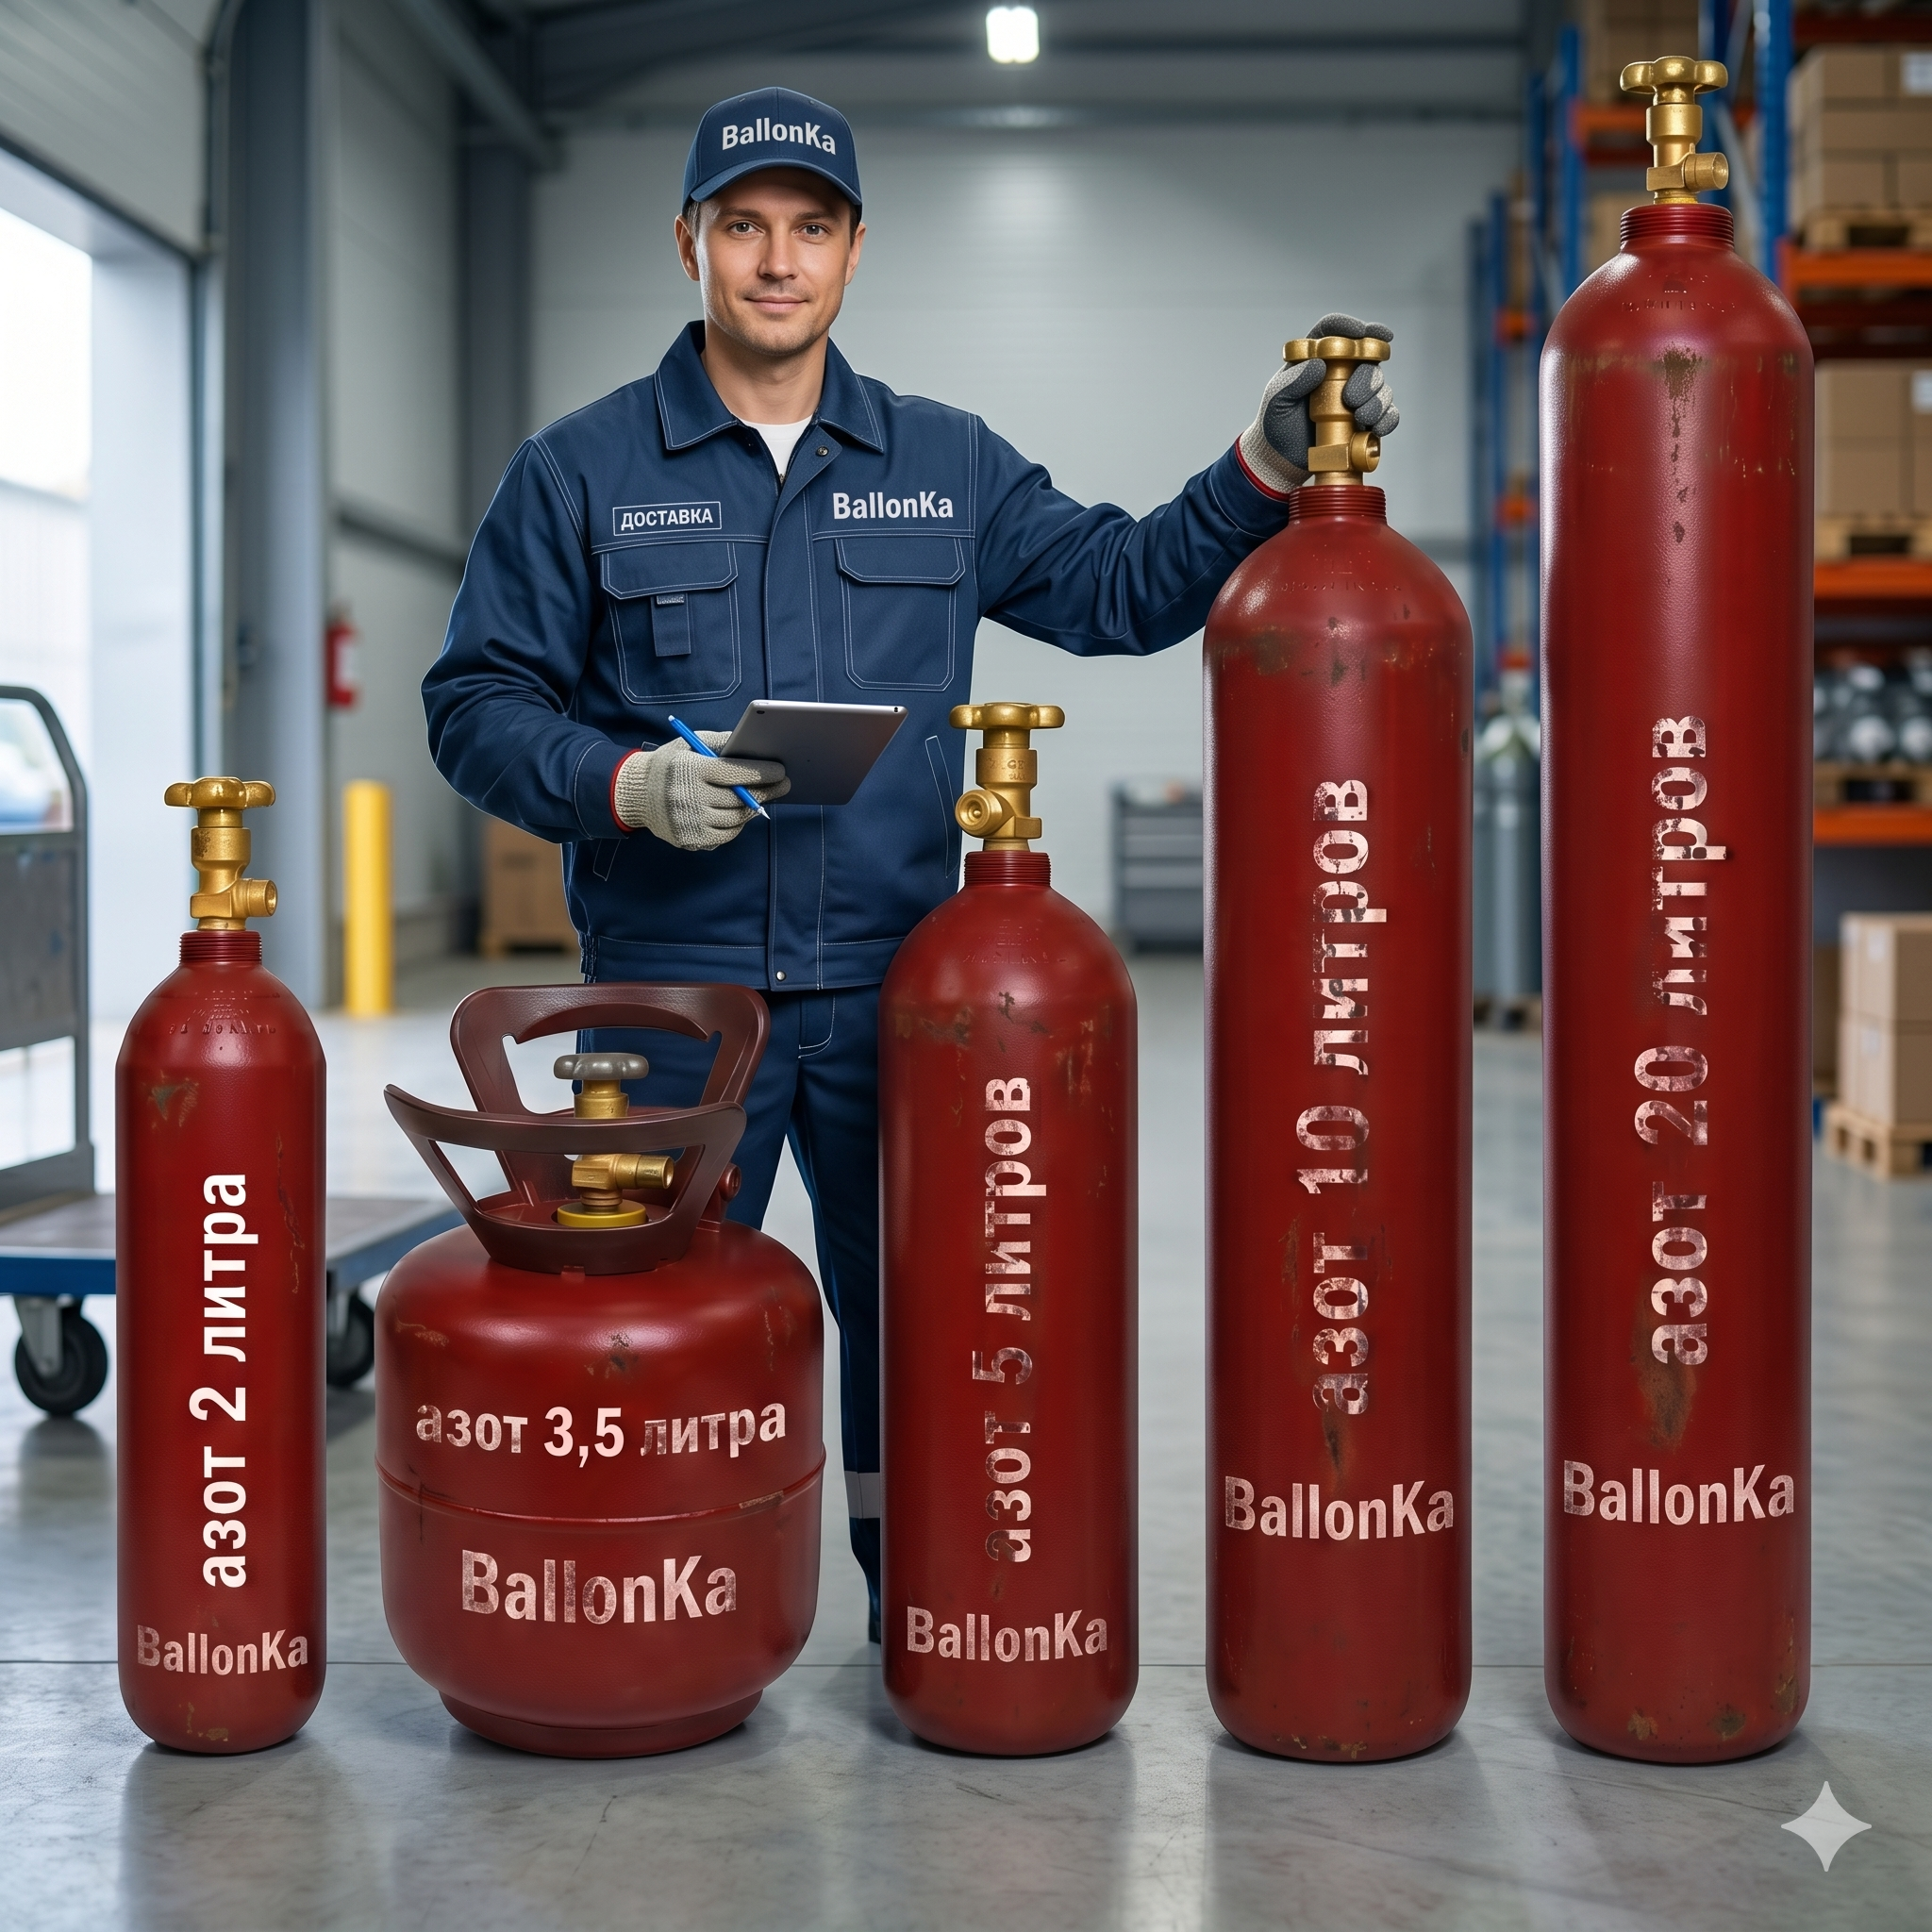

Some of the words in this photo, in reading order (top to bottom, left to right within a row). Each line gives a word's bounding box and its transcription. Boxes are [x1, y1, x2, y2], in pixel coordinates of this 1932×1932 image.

[722, 117, 837, 156] BallonKa
[620, 508, 713, 531] ДОСТАВКА
[832, 491, 954, 520] BallonKa
[1651, 715, 1727, 1016] литров
[1312, 779, 1387, 1075] литров
[1634, 1045, 1708, 1146] 20
[1295, 1105, 1370, 1194] 10
[984, 1077, 1047, 1322] литров
[203, 1174, 258, 1362] литра
[1650, 1180, 1708, 1366] азот
[1312, 1232, 1369, 1415] азот
[972, 1346, 1033, 1385] 5
[189, 1386, 247, 1422] 2
[415, 1405, 528, 1454] азот
[543, 1406, 625, 1468] 3,5
[641, 1402, 787, 1458] литра
[202, 1445, 247, 1589] азот
[984, 1410, 1032, 1563] азот
[1224, 1475, 1454, 1541] BallonKa
[1563, 1459, 1794, 1526] BallonKa
[461, 1549, 737, 1624] BallonKa
[137, 1624, 308, 1675] BallonKa
[907, 1606, 1108, 1663] BallonKa
